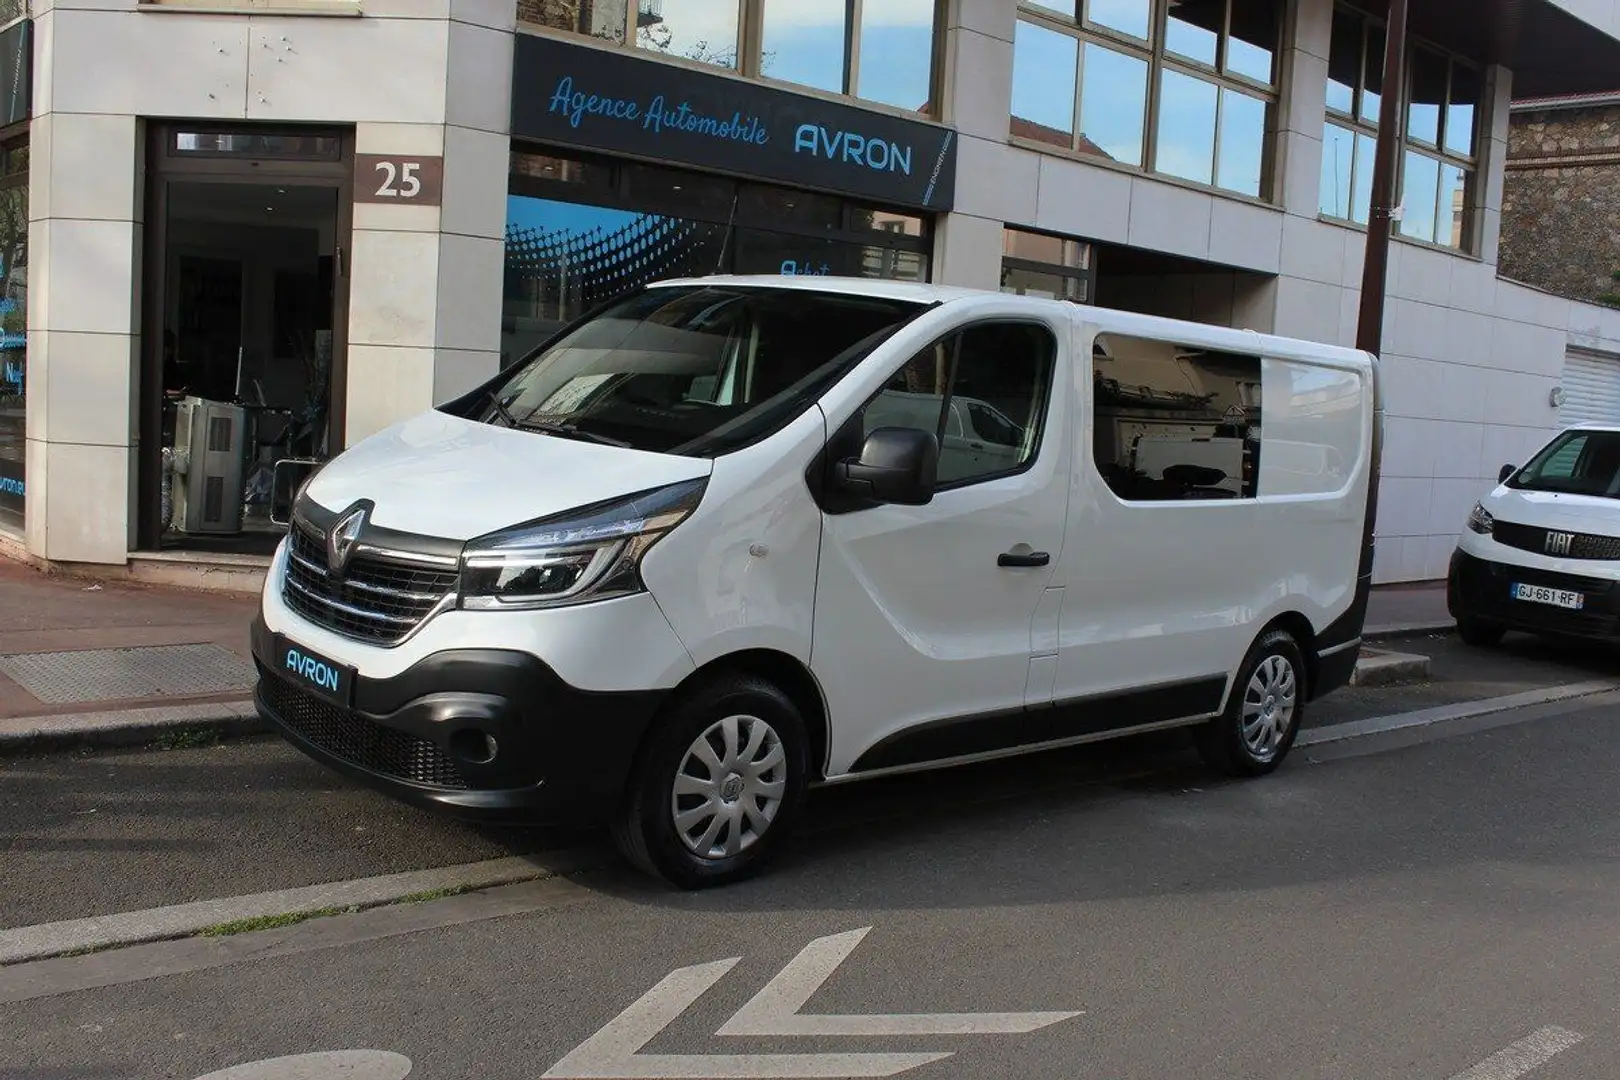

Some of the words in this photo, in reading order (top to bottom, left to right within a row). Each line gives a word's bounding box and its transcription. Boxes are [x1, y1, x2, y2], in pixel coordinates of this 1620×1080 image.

[550, 76, 639, 128] Agence
[643, 95, 769, 145] Automobile
[795, 124, 911, 175] AVRON
[374, 161, 421, 197] 25
[1544, 530, 1575, 556] FIAT
[287, 649, 338, 691] AVRON
